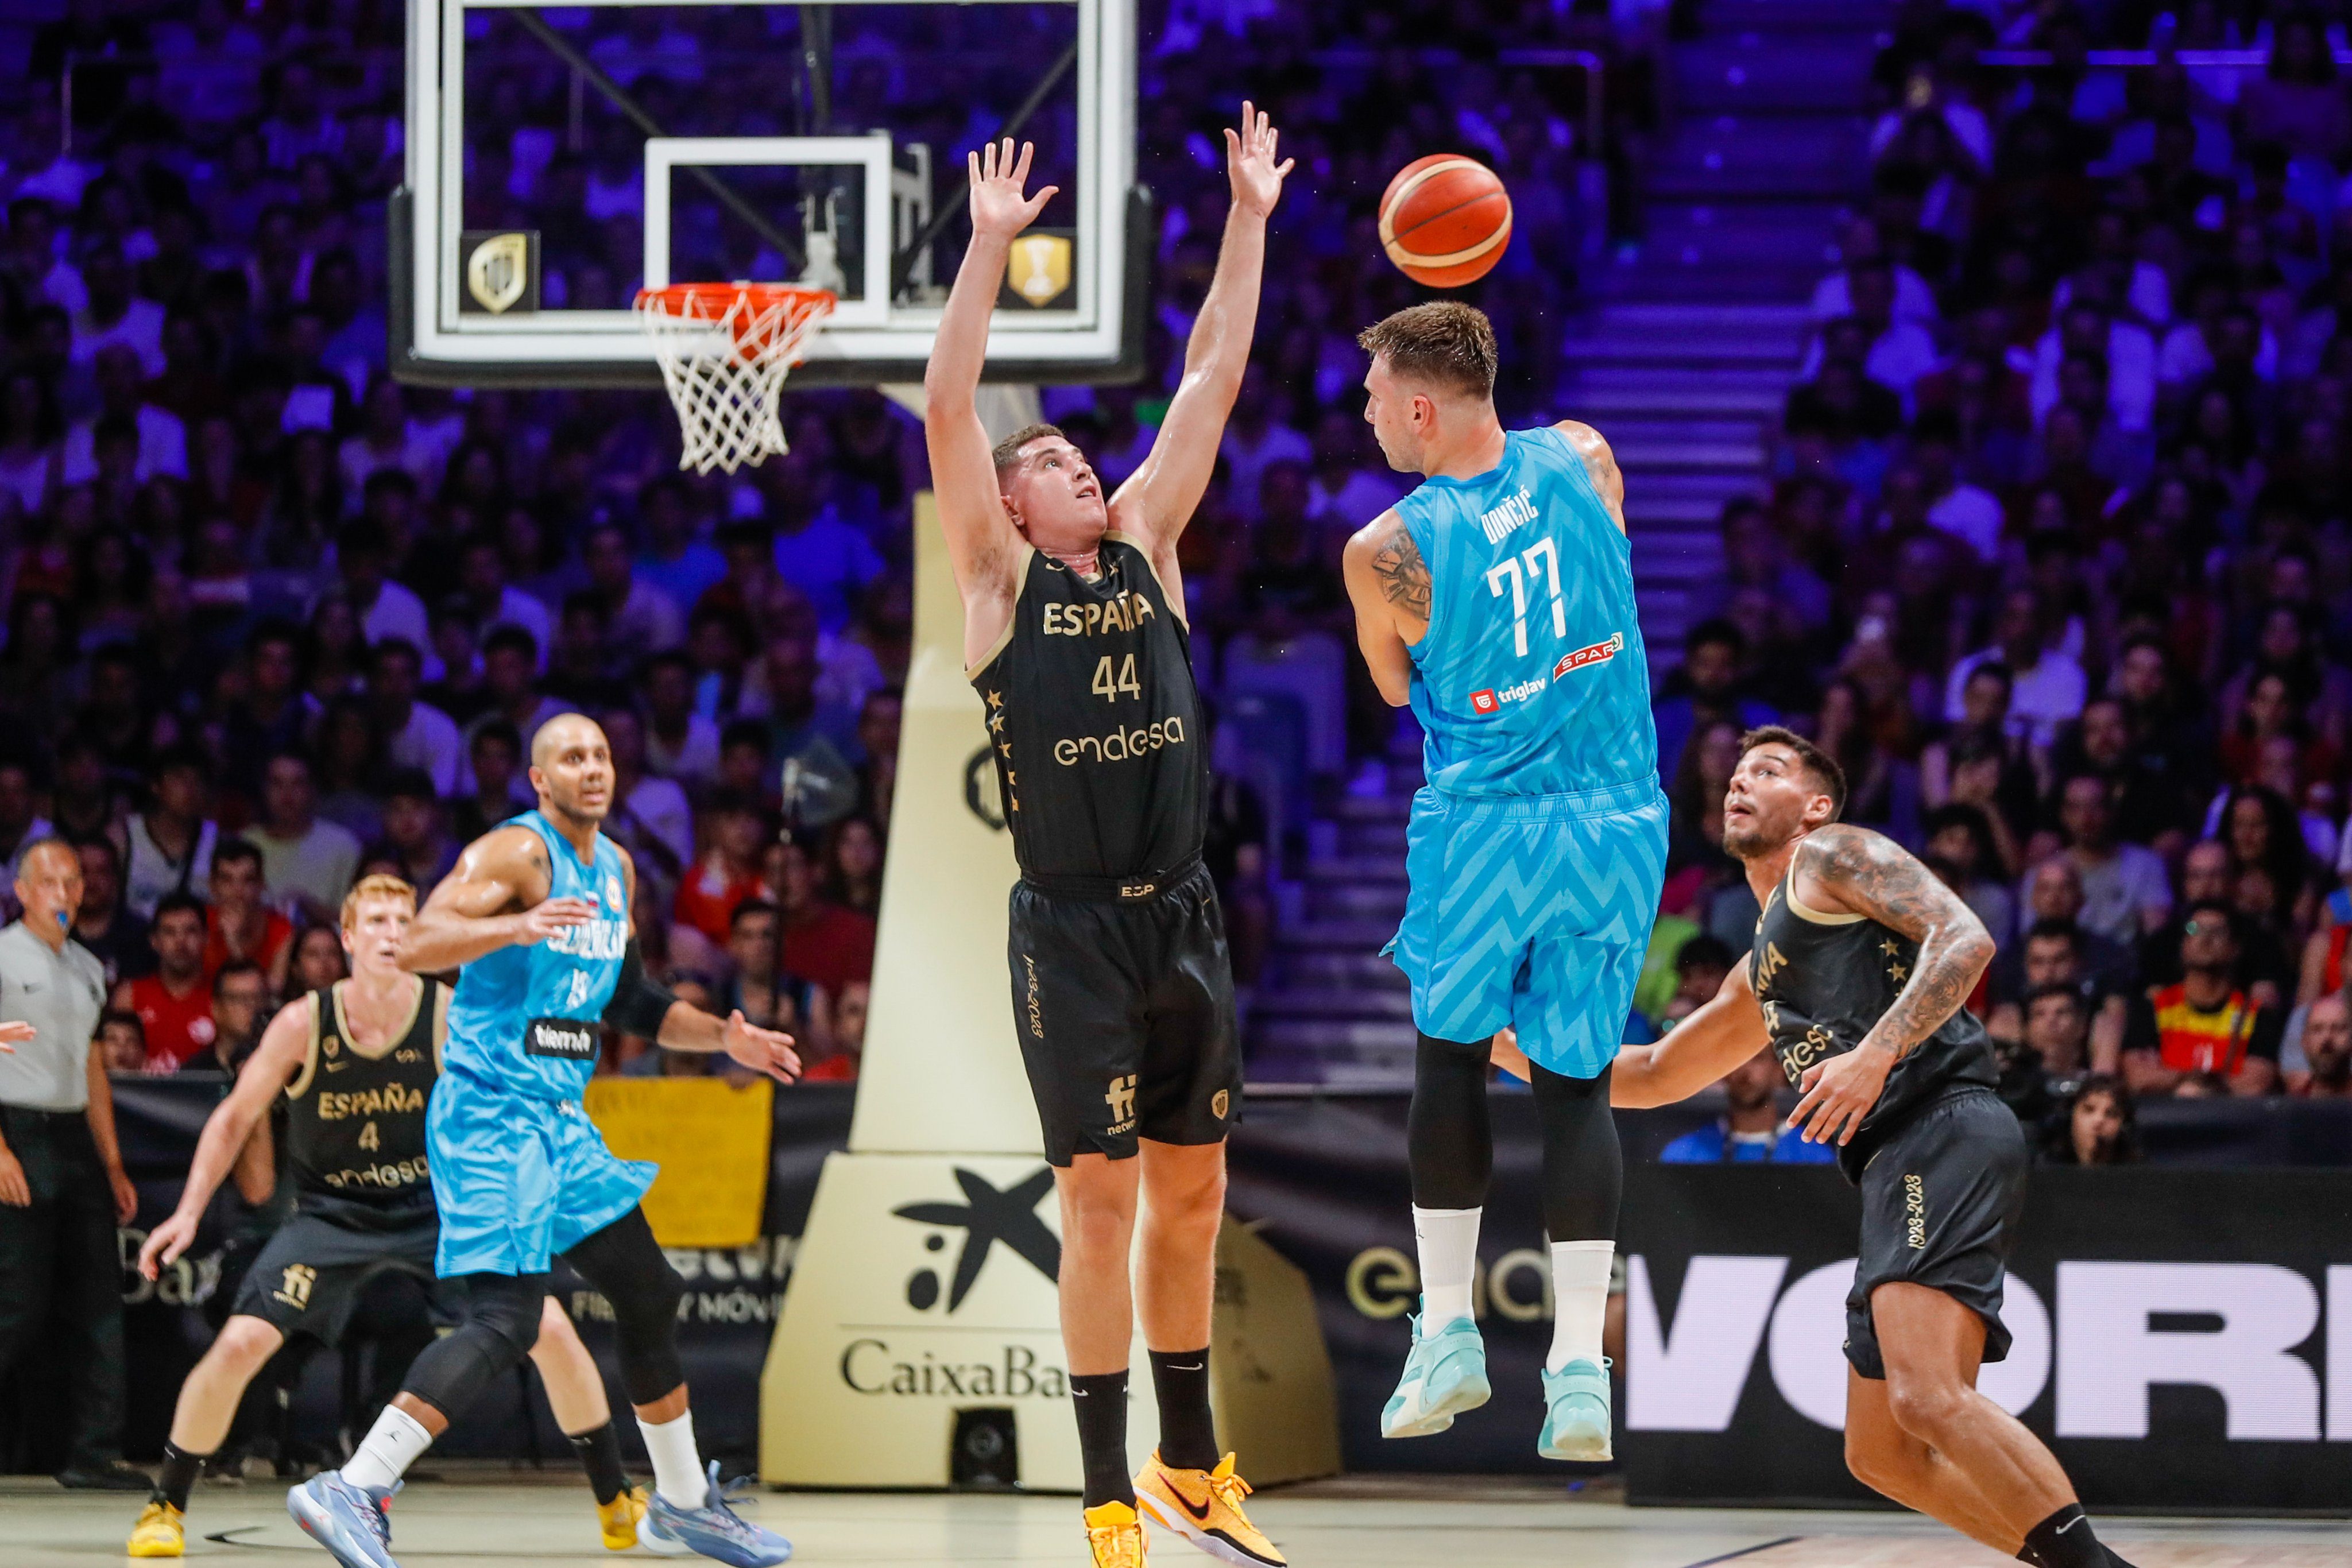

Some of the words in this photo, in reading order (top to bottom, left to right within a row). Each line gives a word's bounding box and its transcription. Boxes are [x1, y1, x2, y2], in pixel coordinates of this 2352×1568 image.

[1480, 484, 1538, 545] DONČIĆ
[1043, 589, 1155, 637] ESPAÑA
[1487, 536, 1566, 658] 77
[1092, 653, 1142, 703] 44
[1561, 643, 1615, 671] SPAR
[1498, 677, 1546, 704] triglav
[1054, 717, 1185, 766] endesa
[318, 1081, 424, 1120] ESPAÑA
[358, 1121, 380, 1152] 4
[1904, 1174, 1925, 1250] 1923-2023
[697, 1285, 787, 1324] MÓVI
